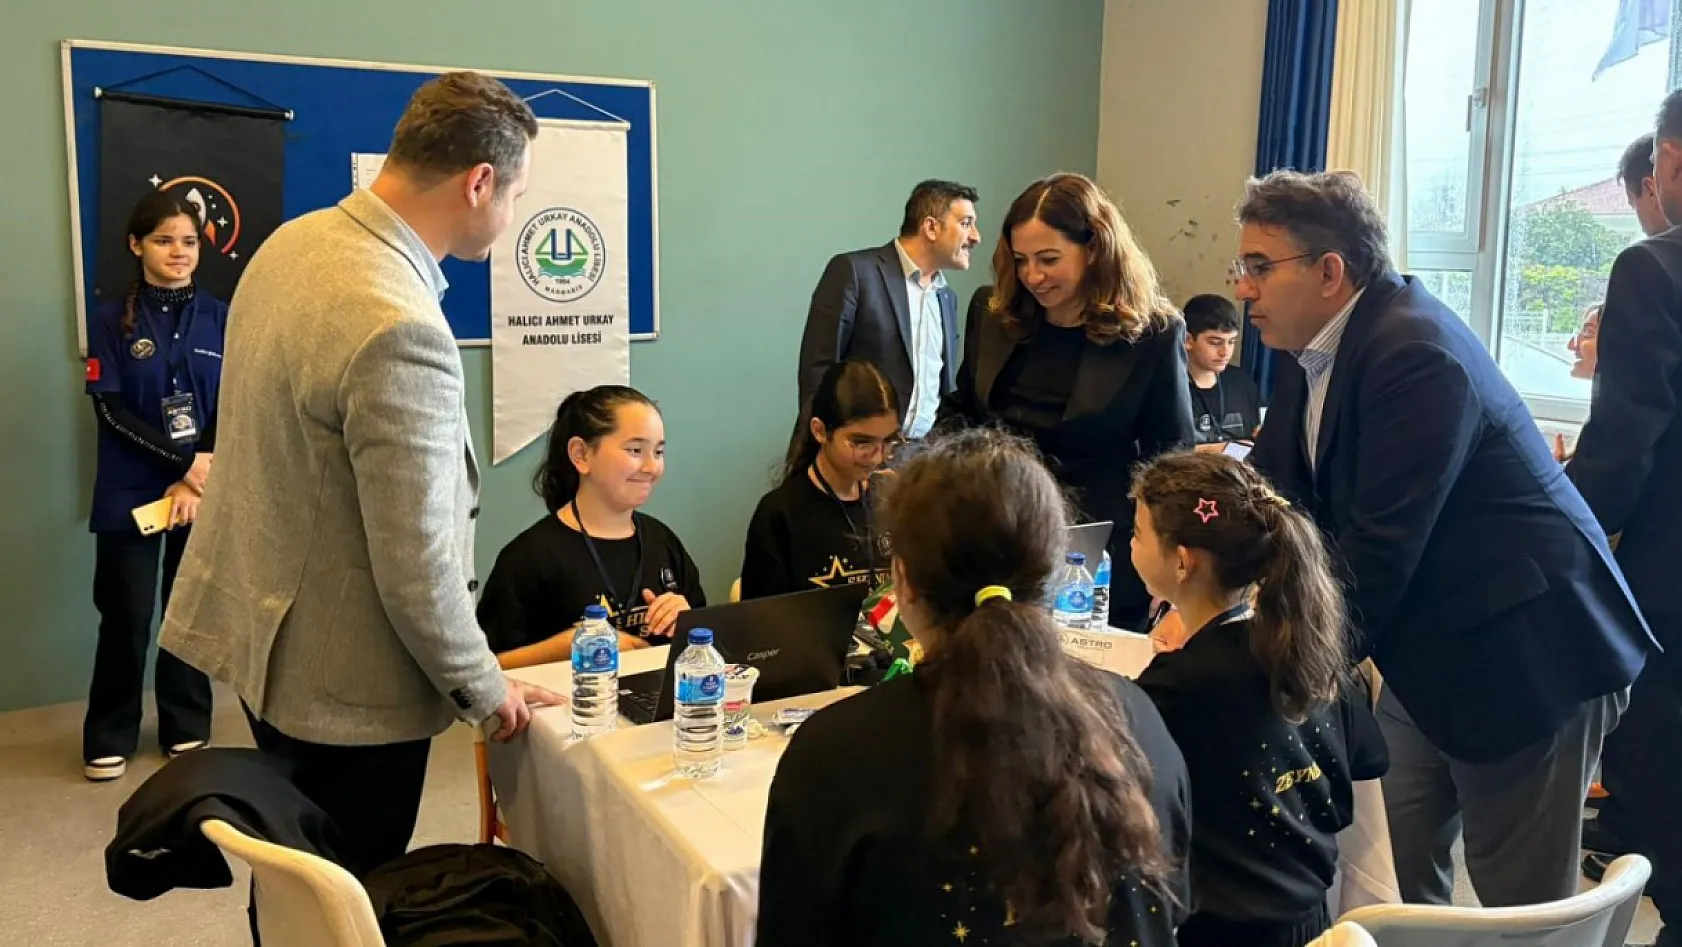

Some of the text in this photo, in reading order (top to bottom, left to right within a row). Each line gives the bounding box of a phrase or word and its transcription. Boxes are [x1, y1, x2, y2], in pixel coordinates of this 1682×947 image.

[507, 314, 614, 327] HALICI AHMET URKAY
[522, 329, 602, 346] ANADOLU LİSESİ
[1070, 637, 1113, 649] ASTRO
[746, 649, 780, 661] Casper
